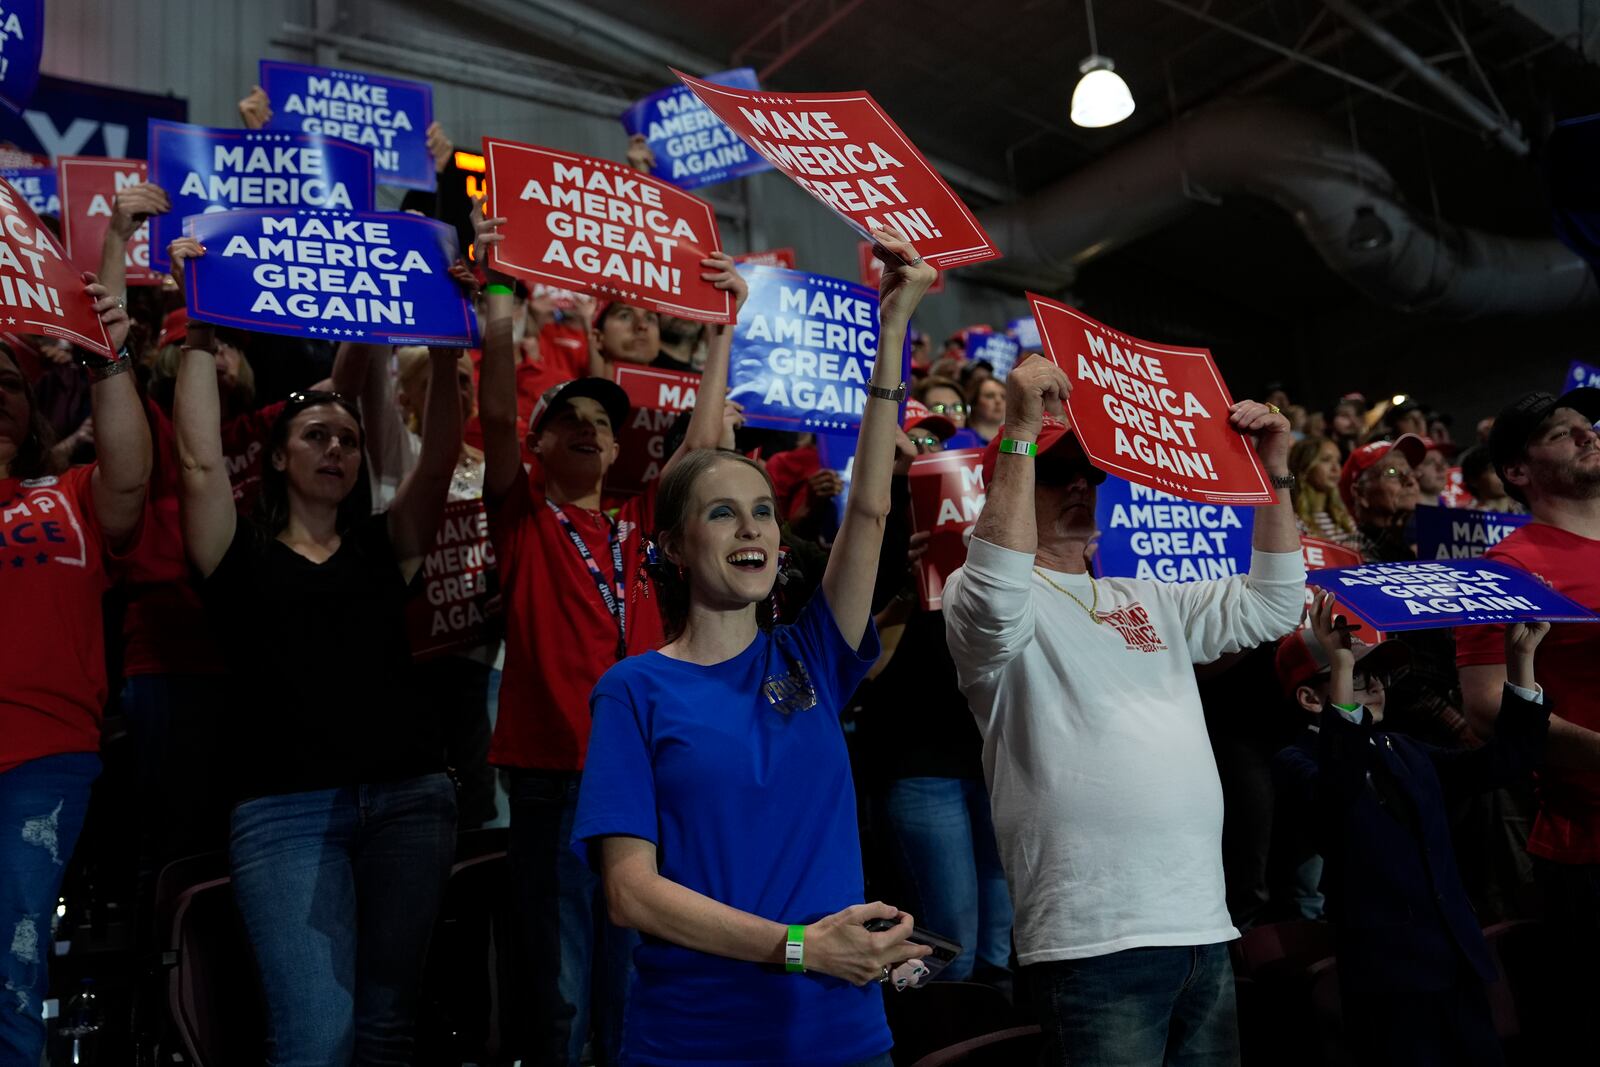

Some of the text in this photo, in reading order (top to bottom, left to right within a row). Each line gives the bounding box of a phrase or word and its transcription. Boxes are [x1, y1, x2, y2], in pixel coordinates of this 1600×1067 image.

[308, 76, 389, 106] MAKE
[284, 94, 413, 131] AMERICA
[738, 106, 849, 141] MAKE
[213, 144, 323, 176] MAKE
[672, 142, 749, 179] AGAIN!
[749, 134, 905, 176] AMERICA
[179, 171, 353, 211] AMERICA
[552, 161, 664, 209] MAKE
[519, 178, 699, 244] AMERICA
[262, 216, 391, 245] MAKE
[545, 210, 678, 263] GREAT
[222, 235, 433, 274] AMERICA
[542, 239, 682, 296] AGAIN!
[252, 263, 408, 298] GREAT
[250, 290, 416, 325] AGAIN!
[779, 285, 873, 328] MAKE
[745, 314, 877, 357] AMERIC
[1083, 329, 1169, 385] MAKE
[1076, 353, 1212, 419] AMERICA
[1102, 393, 1197, 448] GREAT
[1114, 428, 1220, 481] AGAIN!
[1109, 503, 1243, 529] AMERICA
[569, 530, 591, 558] TRUMP
[612, 542, 623, 572] TRUMP
[1129, 531, 1228, 556] GREAT
[1134, 557, 1238, 583] AGAIN!
[1338, 568, 1511, 587] AMERICA
[1339, 562, 1456, 577] MAKE
[598, 582, 617, 615] TRUMP
[1380, 581, 1508, 598] GREAT
[1403, 595, 1542, 616] AGAIN!
